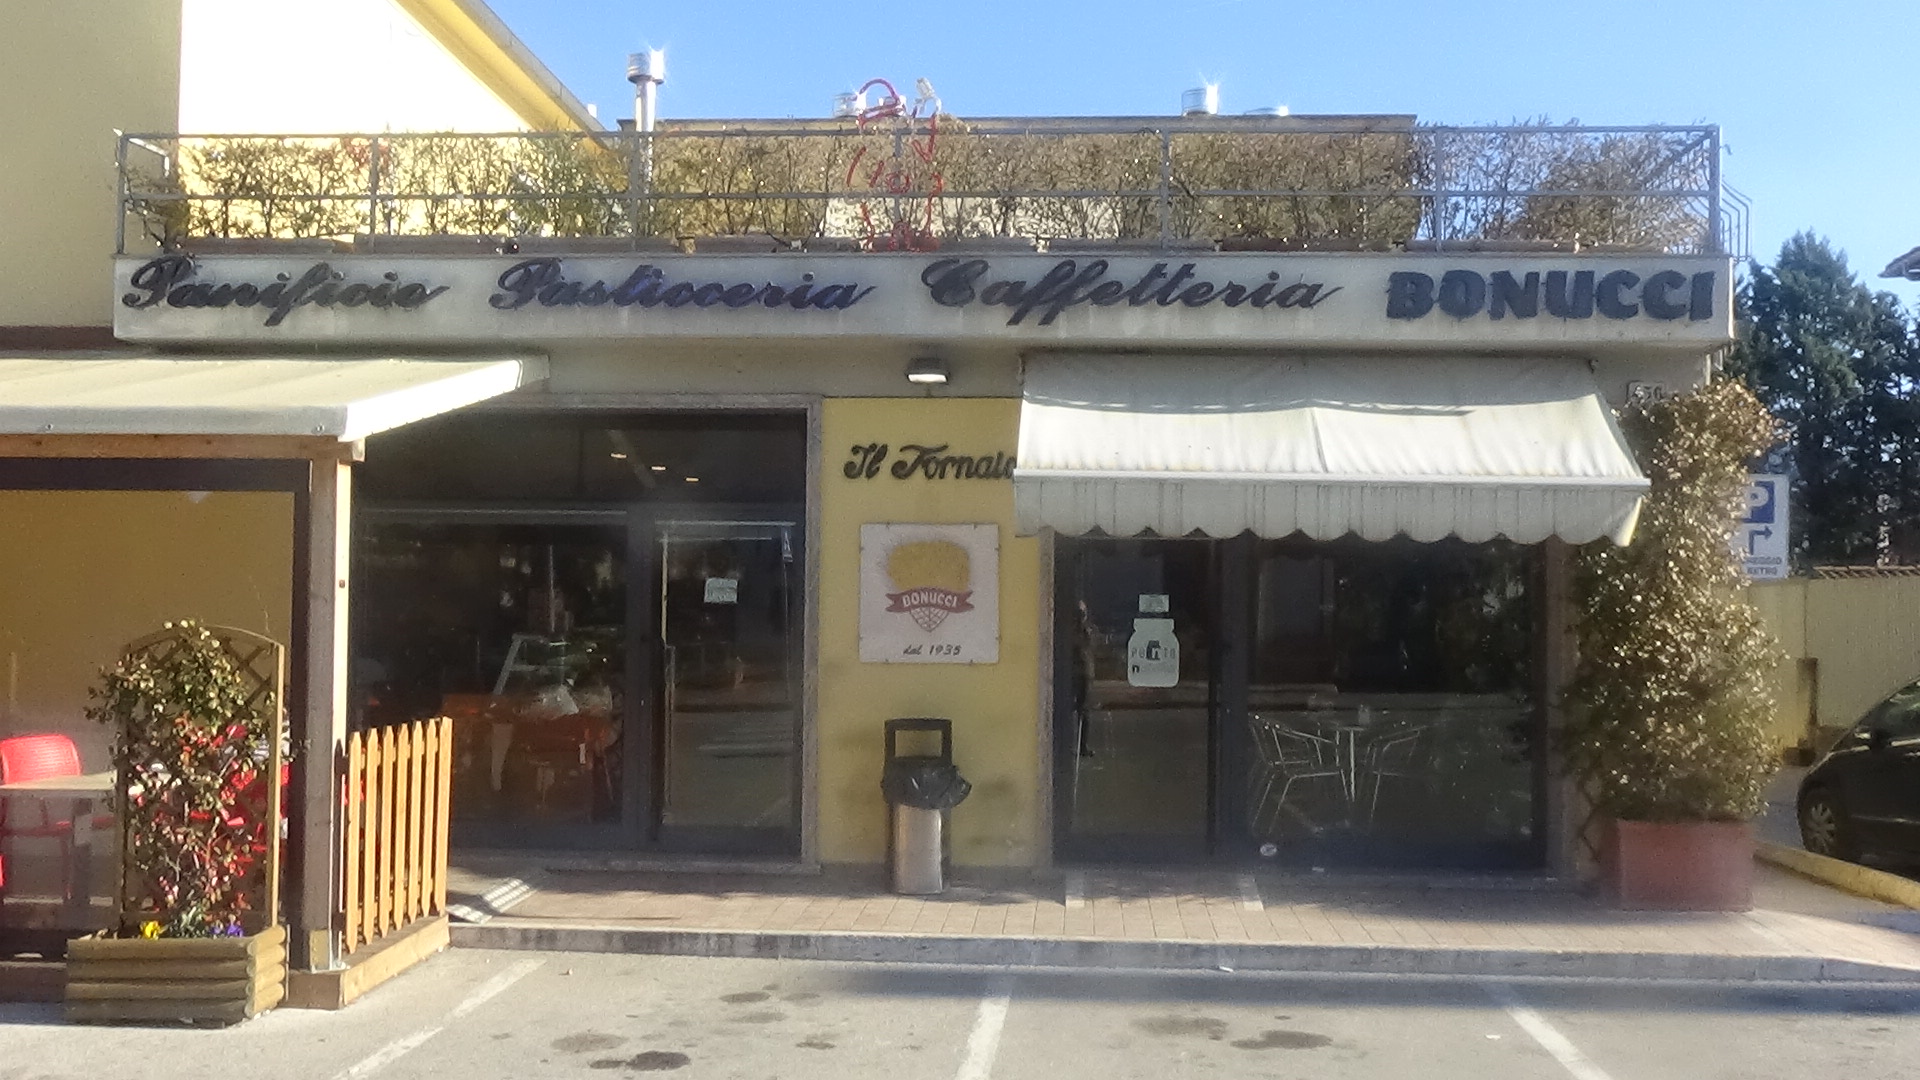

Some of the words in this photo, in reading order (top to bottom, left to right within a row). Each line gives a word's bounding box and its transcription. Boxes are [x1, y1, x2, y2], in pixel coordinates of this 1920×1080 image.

[121, 254, 450, 327] Panificio
[487, 256, 877, 311] Pasticceria
[920, 258, 1344, 326] Caffetteria
[1386, 269, 1716, 321] BONUCCI
[843, 441, 888, 481] Il
[902, 590, 958, 608] BONUCCI
[929, 644, 962, 656] 1935
